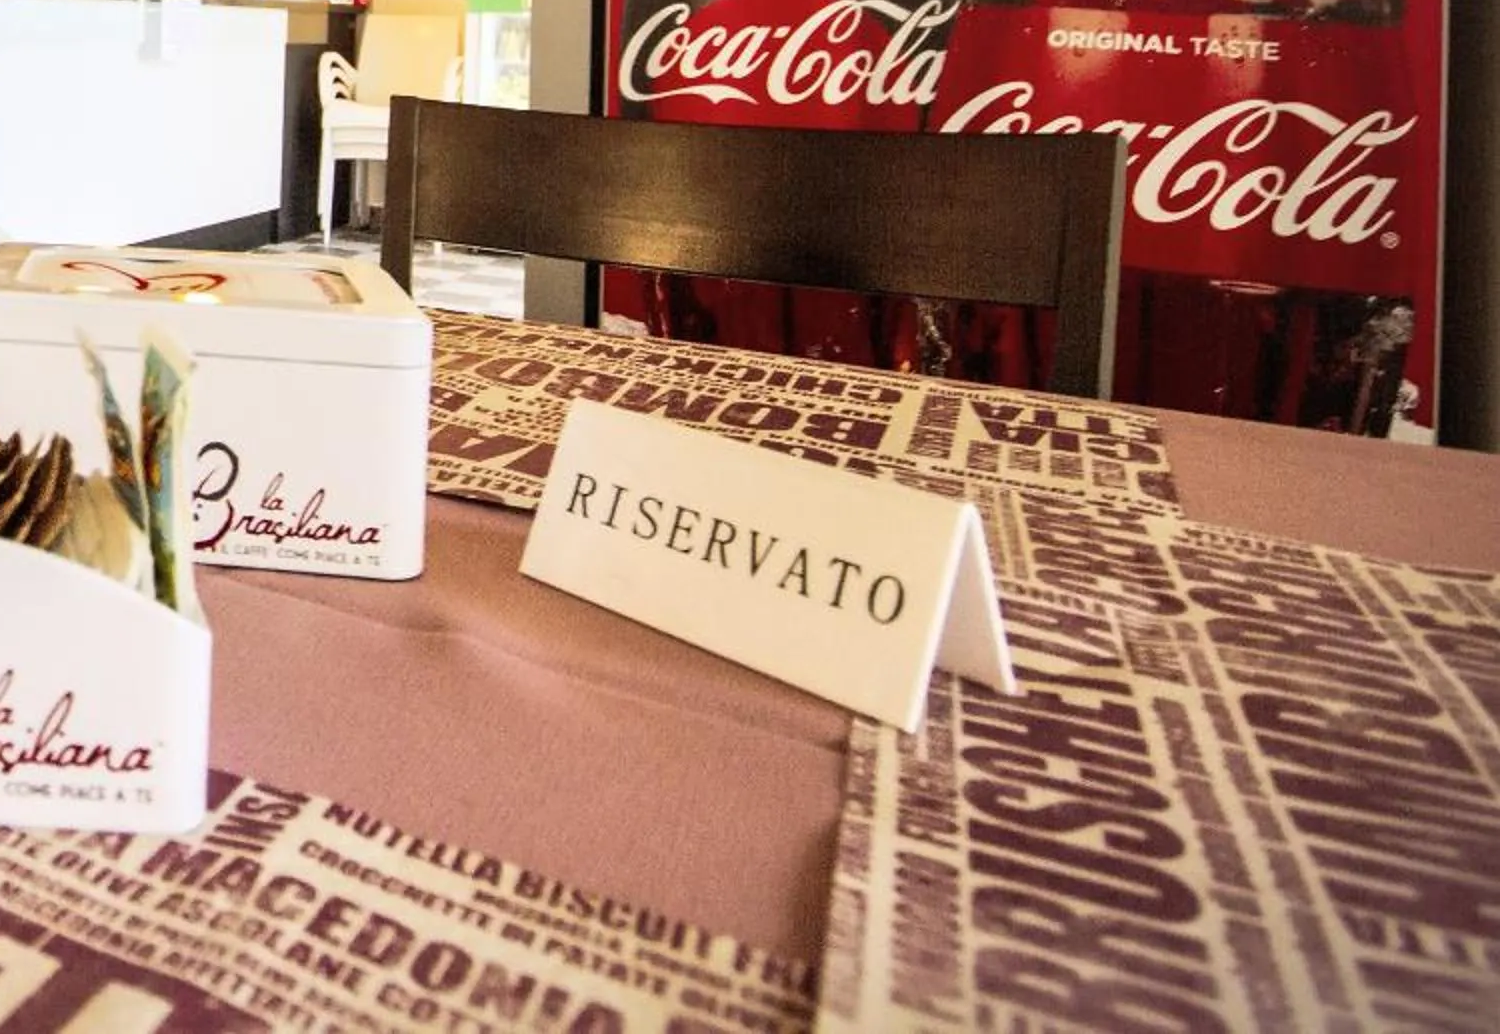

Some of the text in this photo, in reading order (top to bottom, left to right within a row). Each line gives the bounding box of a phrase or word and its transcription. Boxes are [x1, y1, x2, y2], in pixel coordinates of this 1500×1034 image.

[1047, 28, 1282, 62] ORIGINAL TASTE
[583, 343, 905, 404] CHICKEN
[260, 471, 284, 511] la
[564, 472, 910, 627] RISERVATO
[3, 781, 51, 797] COME
[59, 784, 106, 801] PIACE
[115, 790, 126, 804] A
[322, 801, 503, 886] NUTELLA
[513, 869, 711, 960] BISCUIT
[51, 849, 152, 903] OLIVE
[154, 891, 365, 995] ASCOLANE
